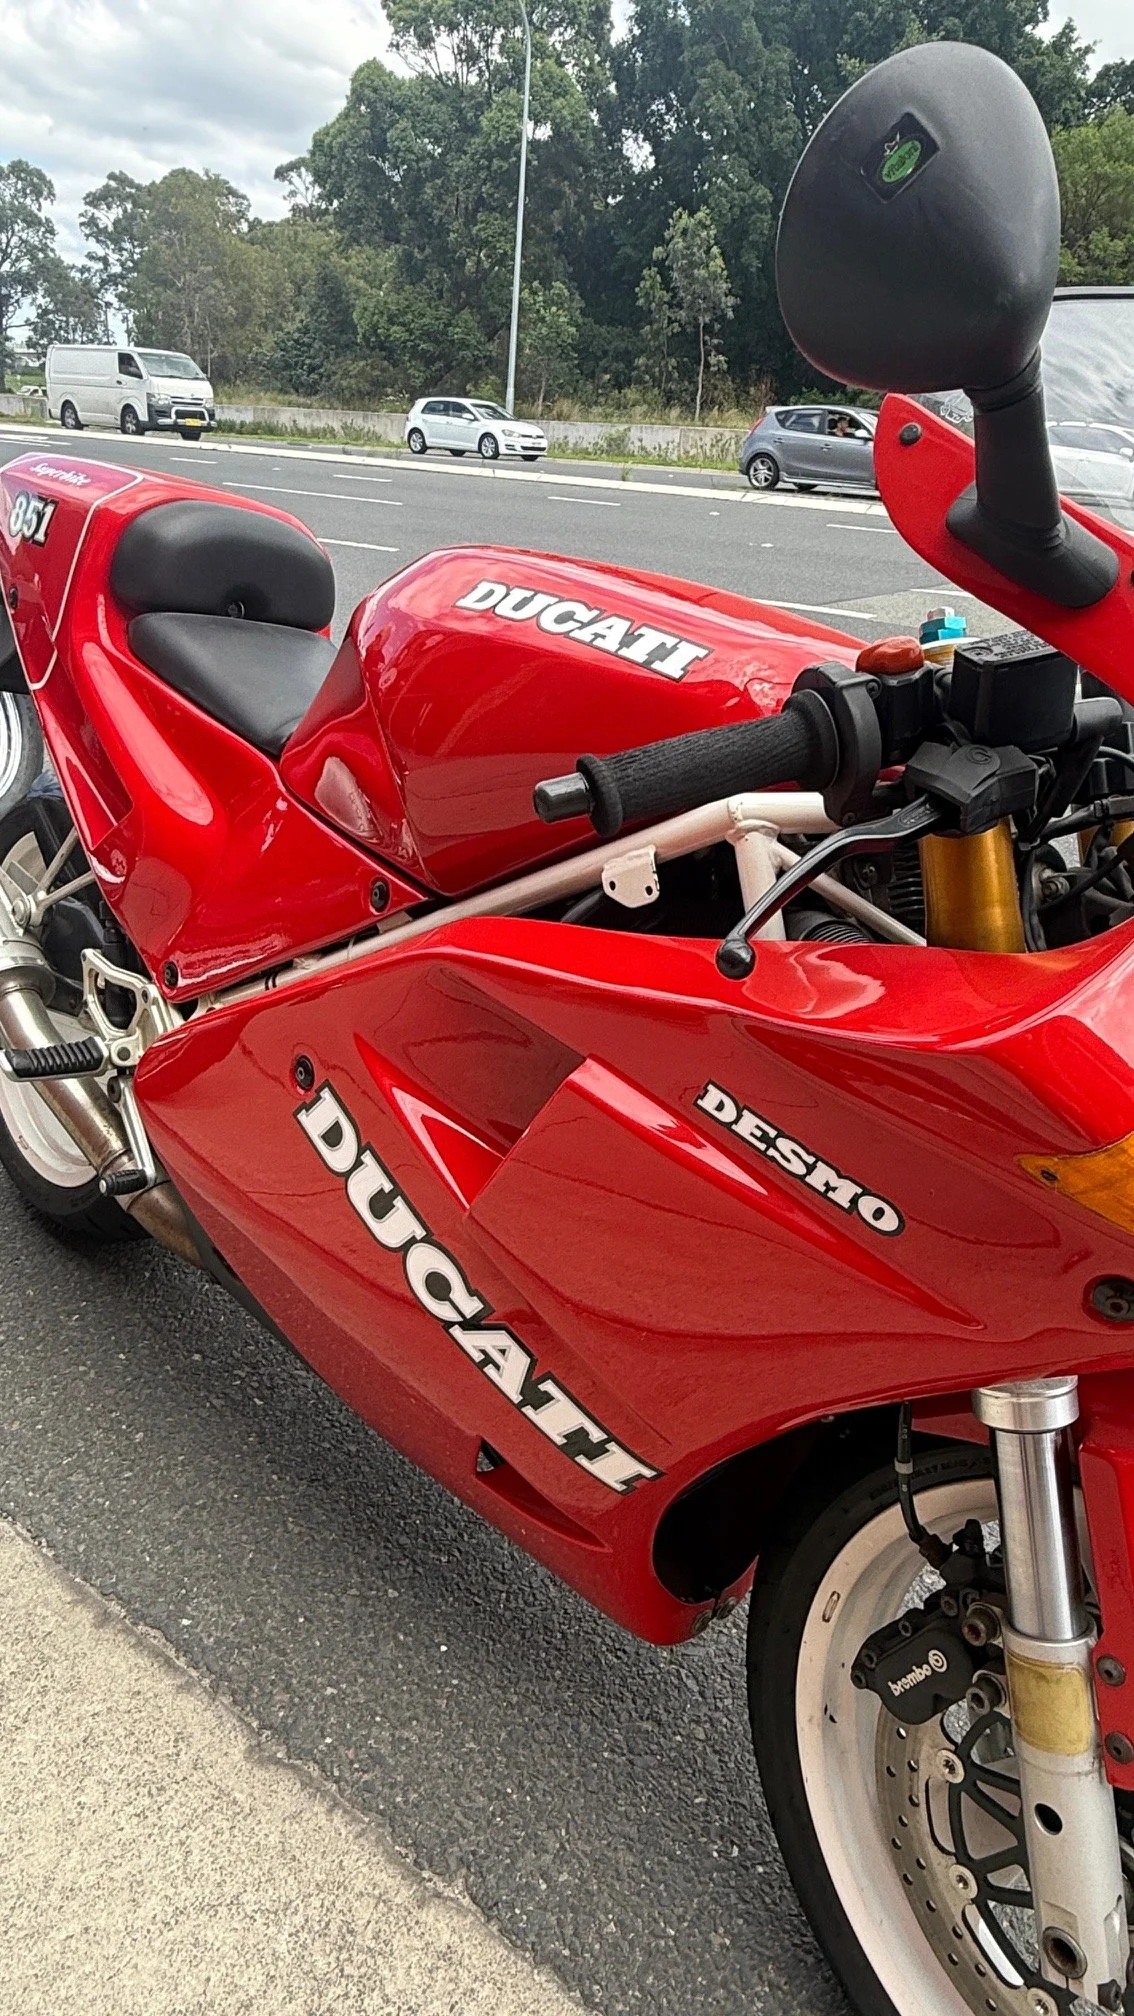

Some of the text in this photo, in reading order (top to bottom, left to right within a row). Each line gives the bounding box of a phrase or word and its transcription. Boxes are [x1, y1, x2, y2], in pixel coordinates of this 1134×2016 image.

[9, 492, 58, 547] 851
[453, 580, 714, 681] DUCATI
[695, 1081, 903, 1235] DESMO
[295, 1083, 662, 1493] DUCATI
[887, 1663, 932, 1697] brembo
